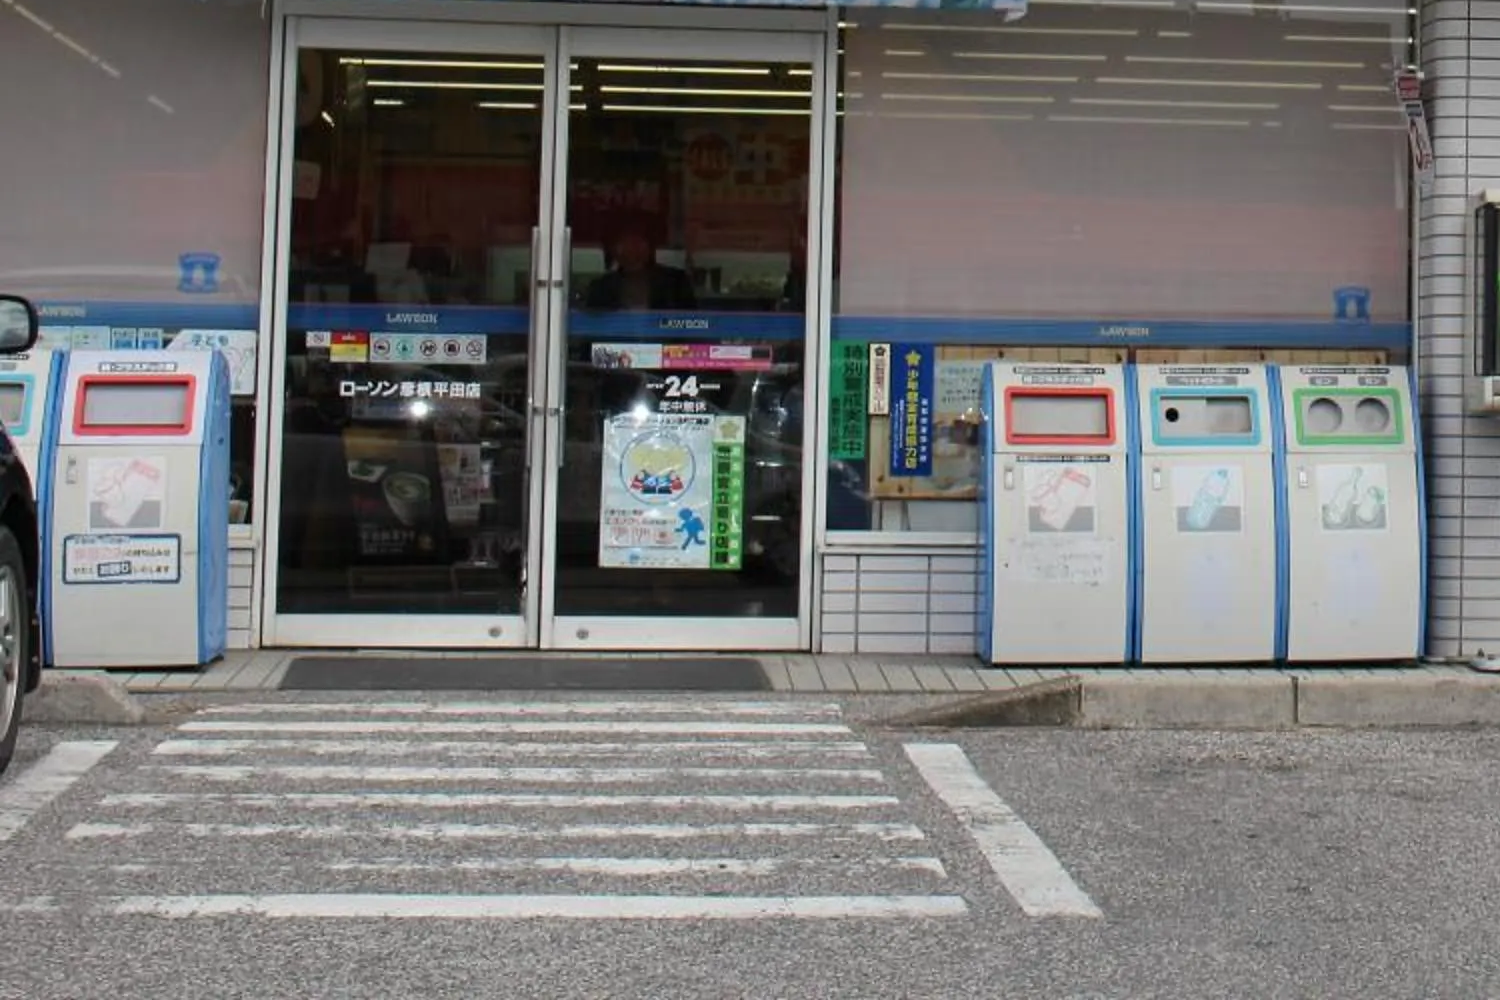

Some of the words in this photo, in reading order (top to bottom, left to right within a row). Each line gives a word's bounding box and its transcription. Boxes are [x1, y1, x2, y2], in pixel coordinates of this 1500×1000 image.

[385, 312, 438, 324] LAWSON
[658, 318, 710, 330] LAWSON
[1099, 325, 1150, 338] LAWSON
[664, 376, 700, 397] 24
